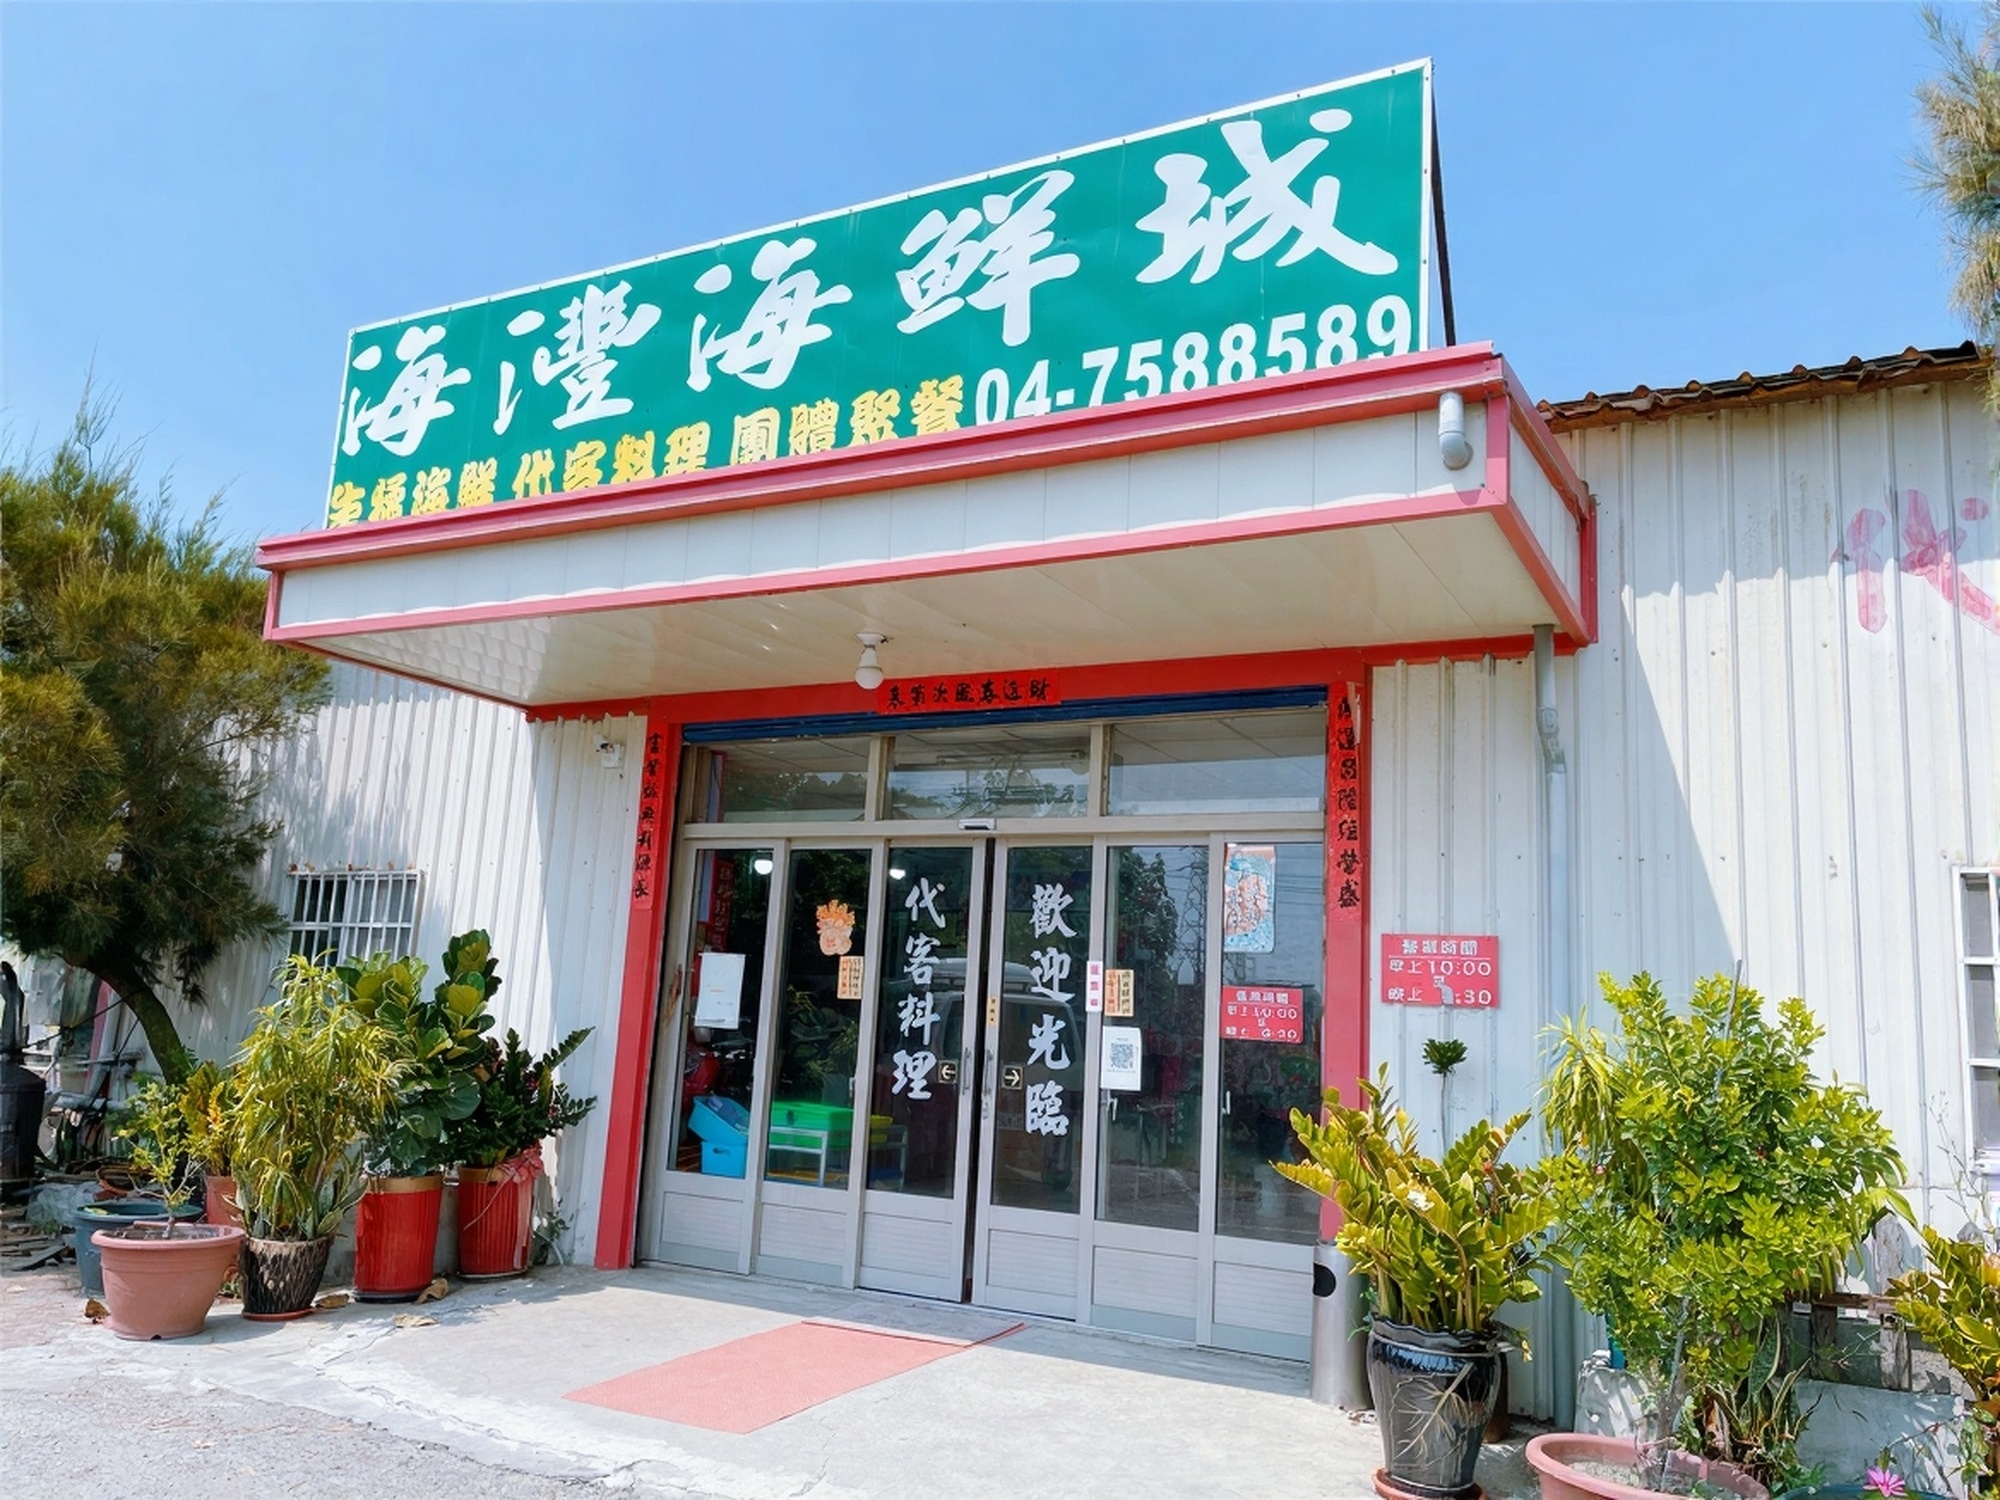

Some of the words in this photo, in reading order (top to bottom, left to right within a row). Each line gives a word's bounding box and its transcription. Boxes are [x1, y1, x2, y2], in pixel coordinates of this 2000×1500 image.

[512, 421, 711, 501] 代客料理
[731, 374, 964, 466] 團體聚餐
[975, 294, 1412, 427] 04-7588589
[891, 877, 947, 1100] 代客料理
[1025, 882, 1077, 1137] 歡迎光臨
